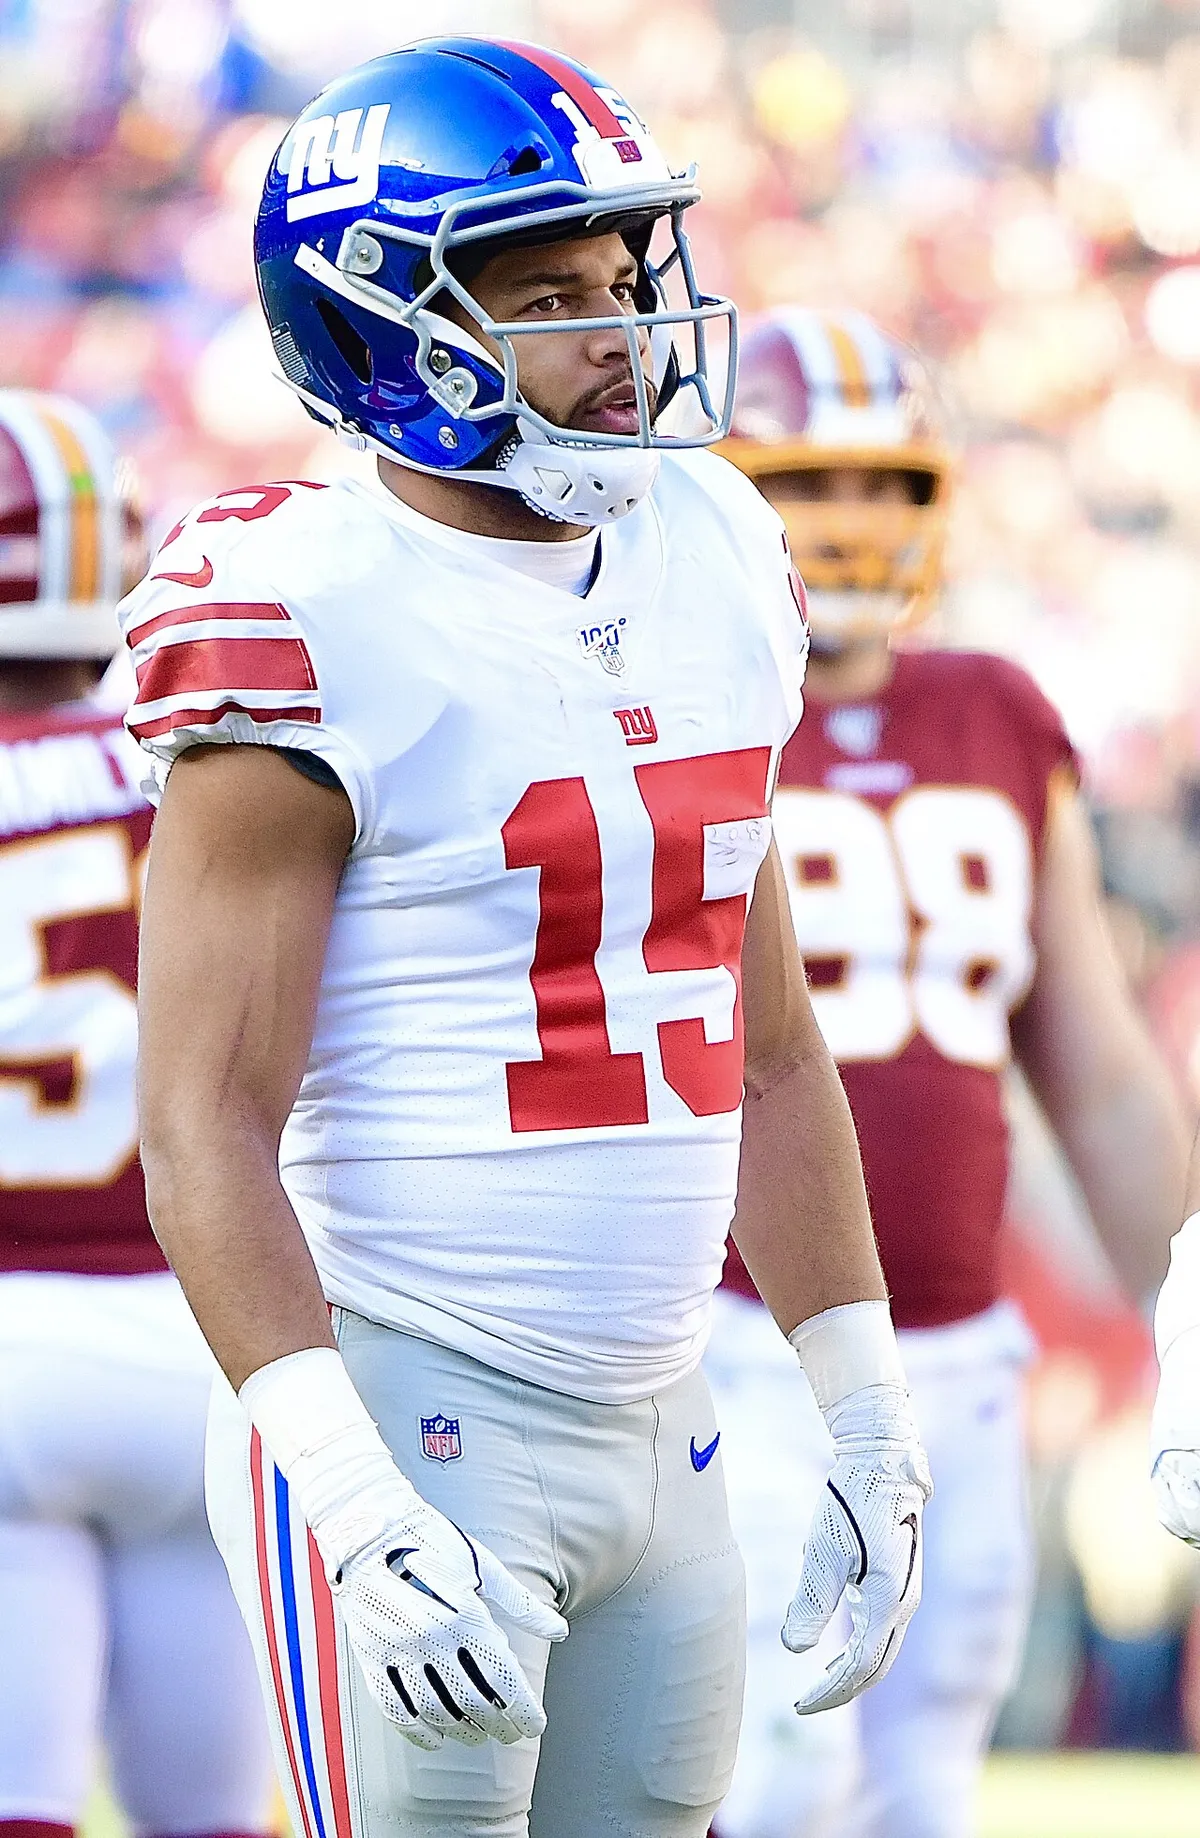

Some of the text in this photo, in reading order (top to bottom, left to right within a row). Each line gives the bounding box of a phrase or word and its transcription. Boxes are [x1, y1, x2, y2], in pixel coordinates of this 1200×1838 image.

[613, 706, 659, 746] ny
[500, 744, 773, 1133] 15
[771, 786, 1037, 1071] 98
[425, 1435, 459, 1458] NFL
